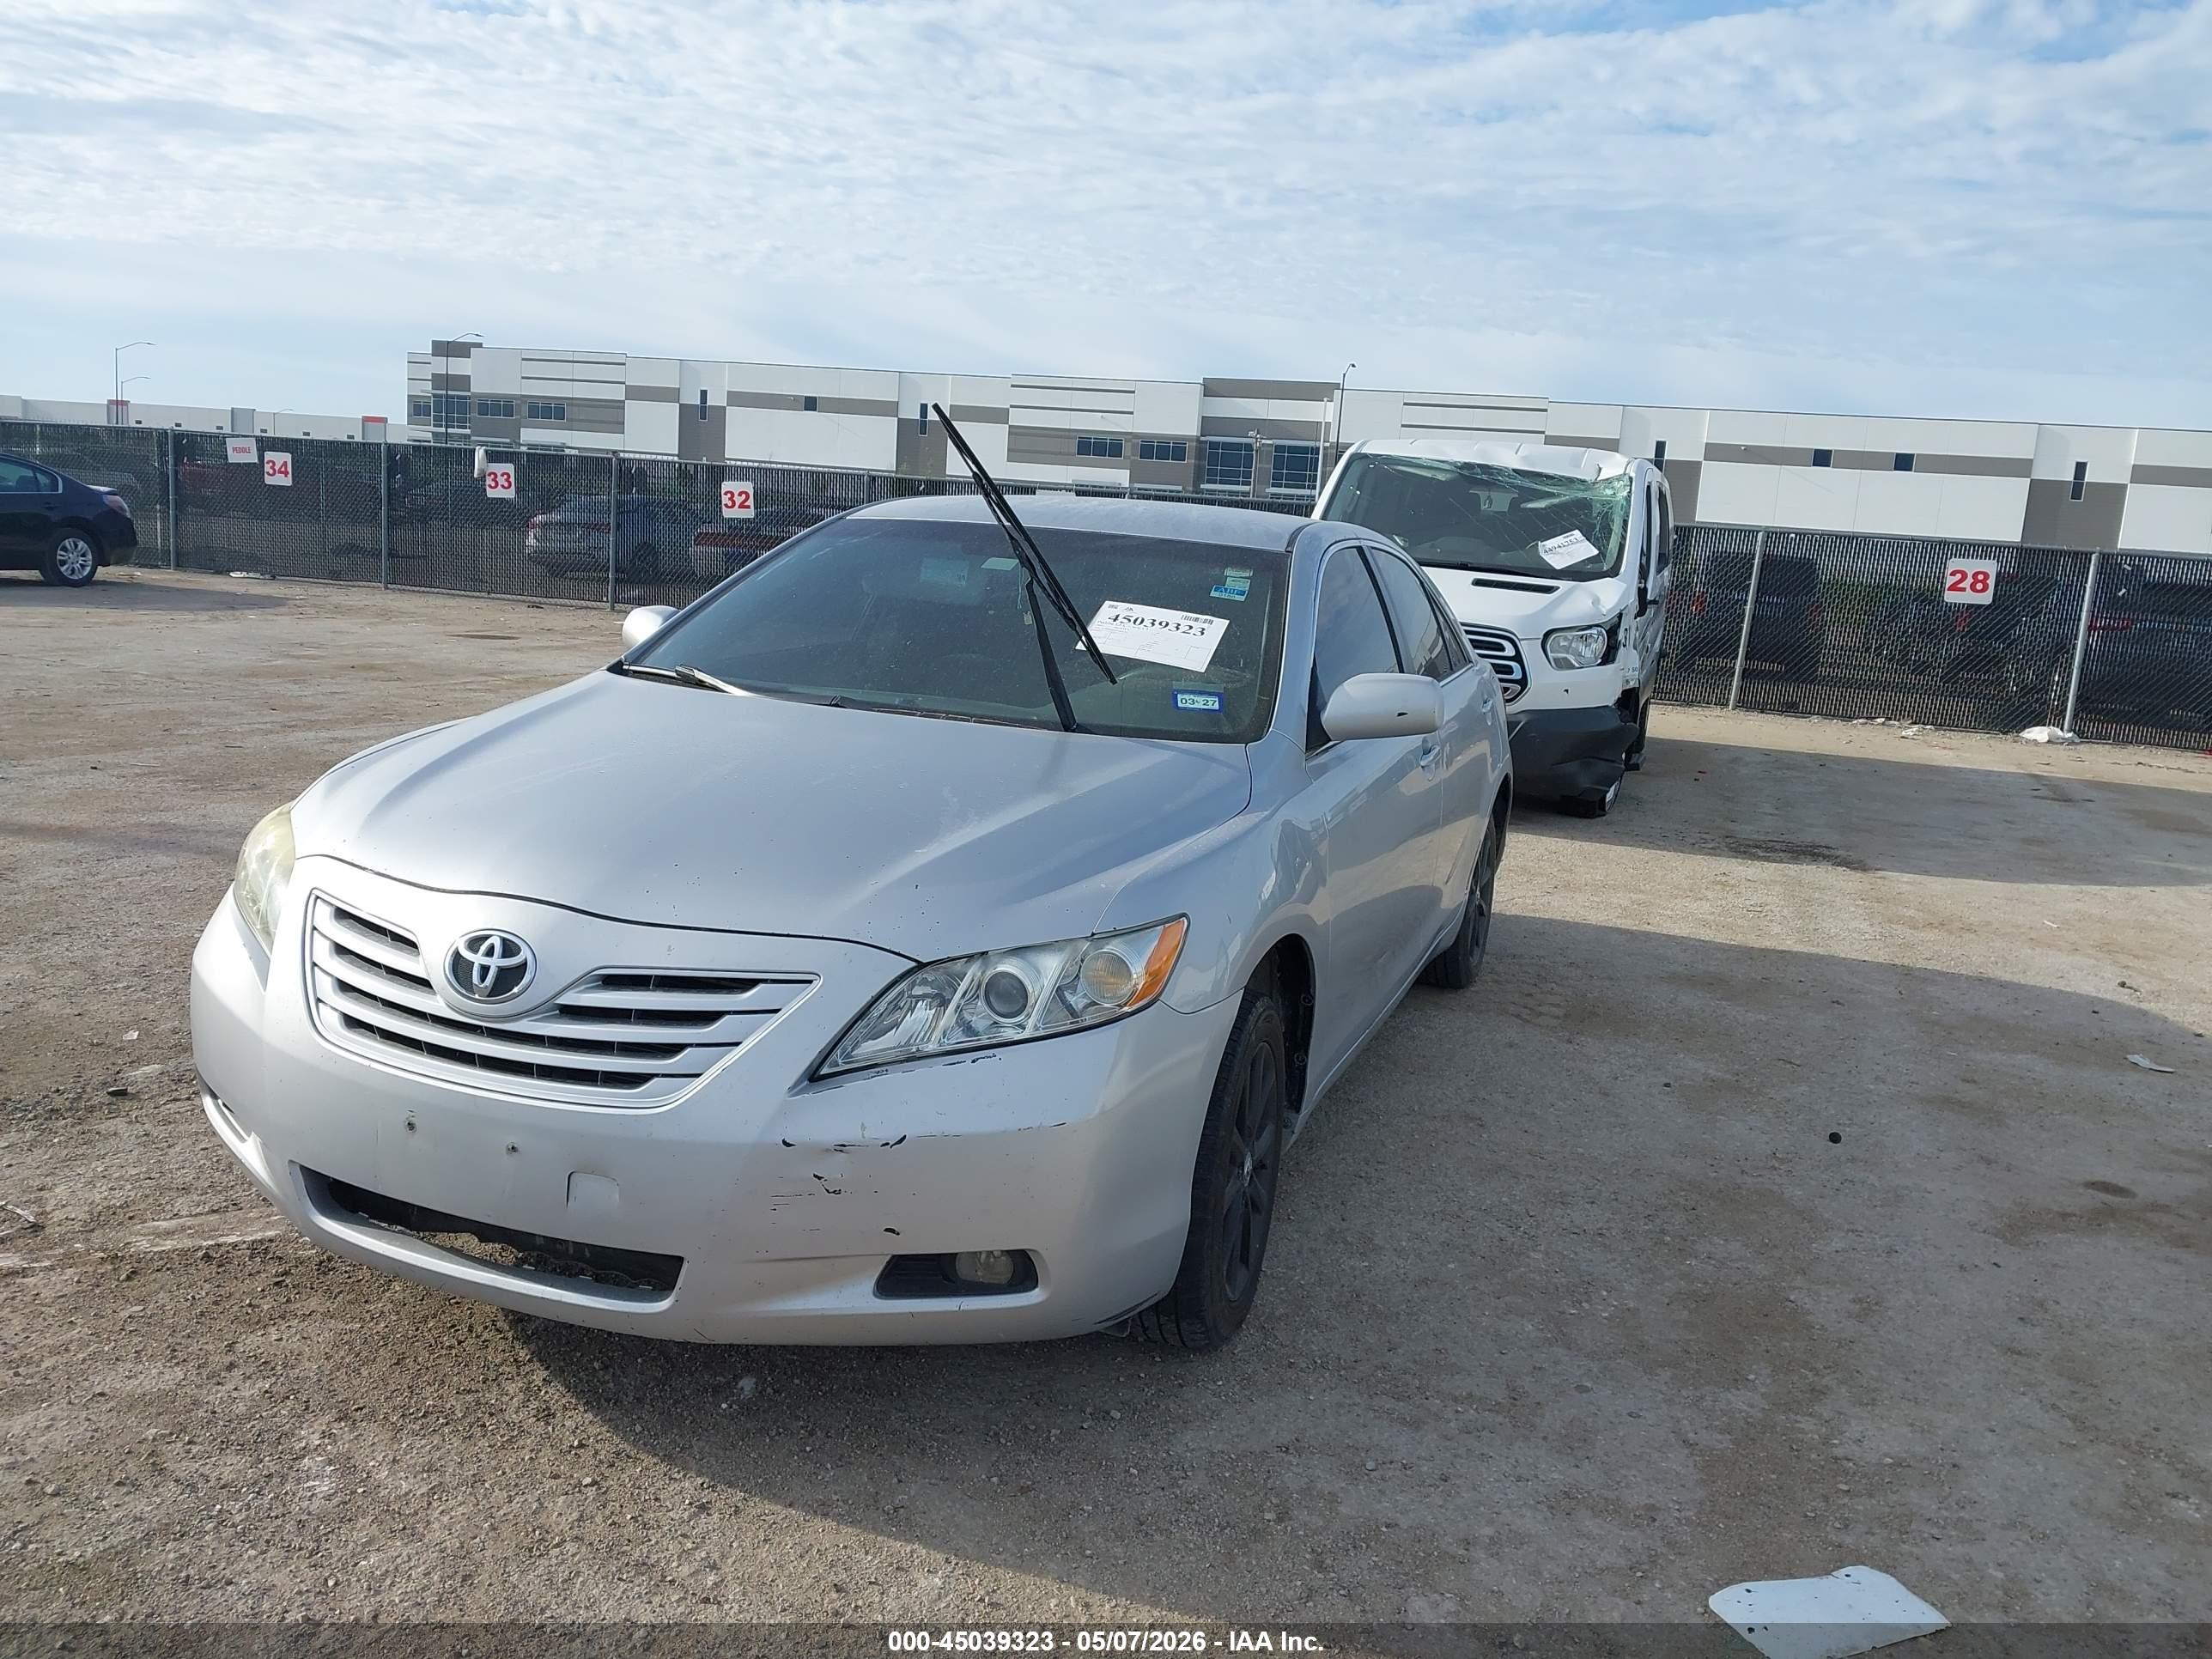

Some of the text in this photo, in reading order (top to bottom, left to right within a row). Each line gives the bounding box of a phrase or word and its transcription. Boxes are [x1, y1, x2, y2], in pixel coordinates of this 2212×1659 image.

[265, 459, 289, 478] 34
[487, 471, 513, 490] 33
[723, 490, 750, 509] 32
[1947, 569, 1990, 593] 28
[1108, 612, 1206, 638] 45039323
